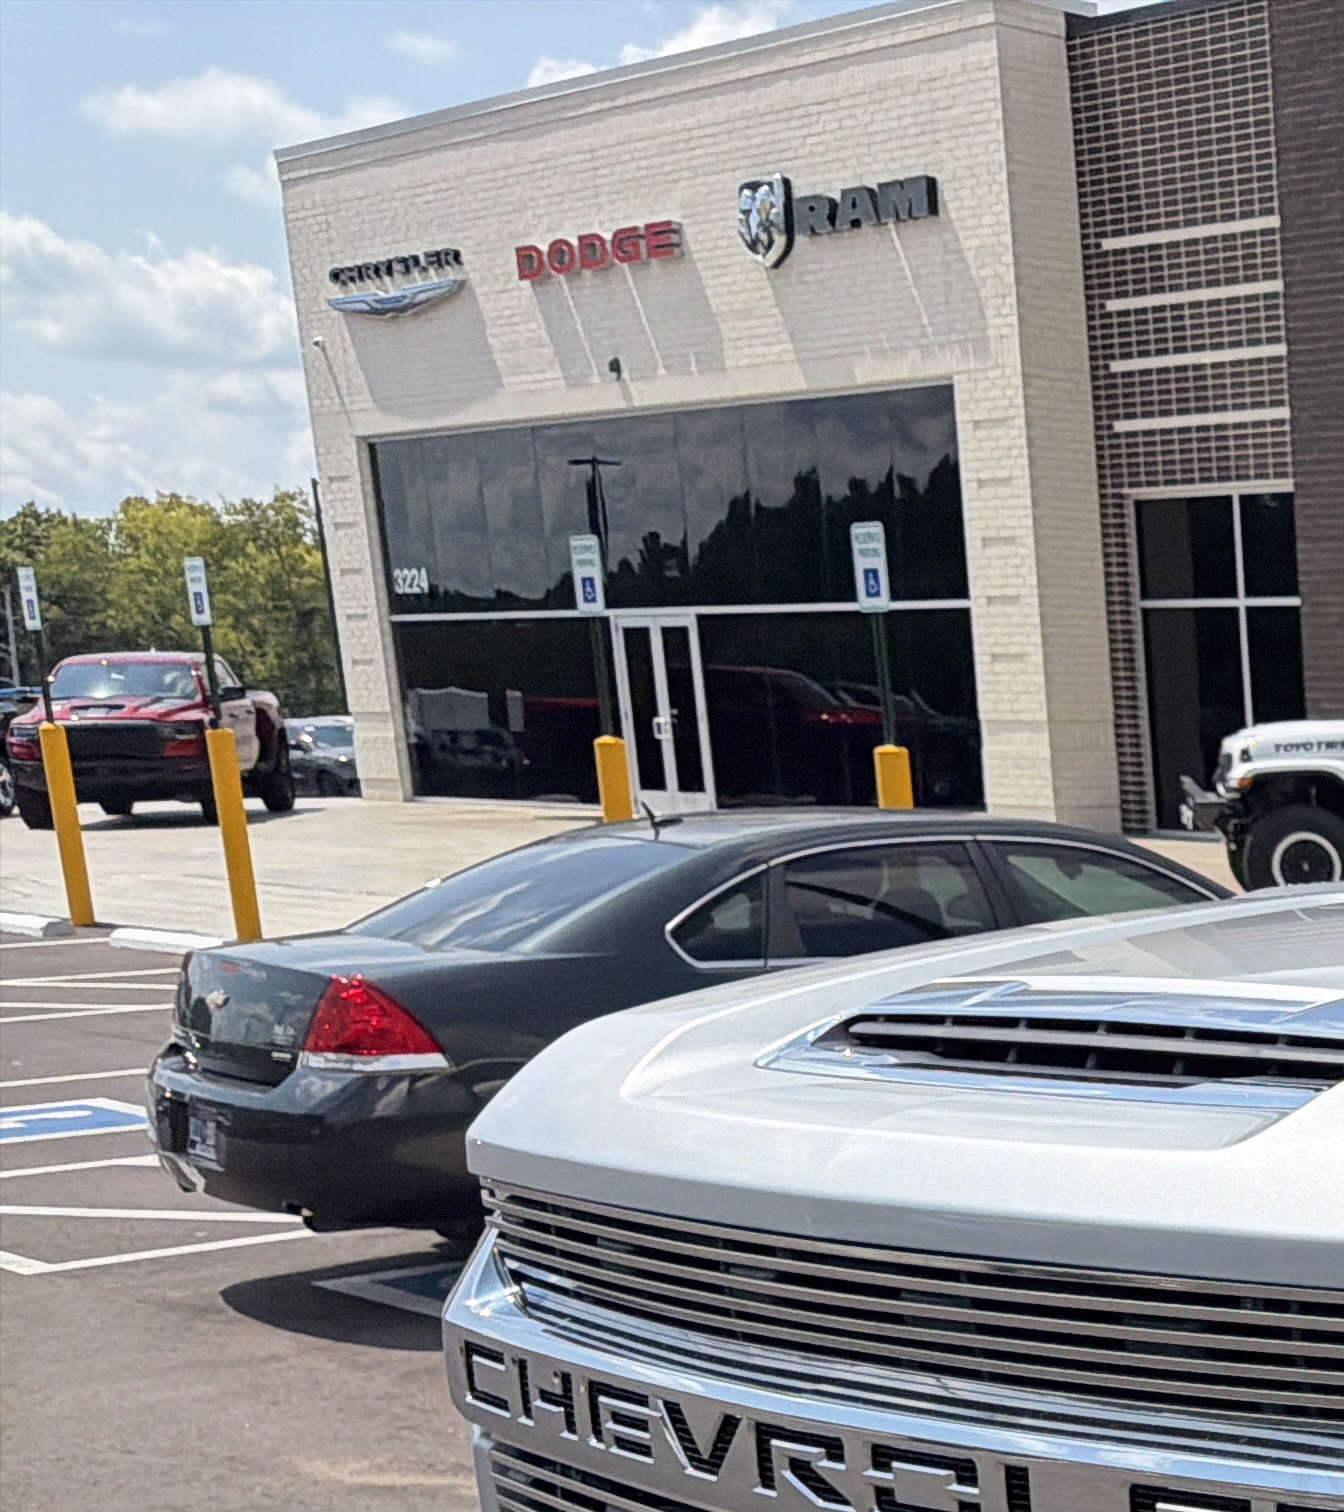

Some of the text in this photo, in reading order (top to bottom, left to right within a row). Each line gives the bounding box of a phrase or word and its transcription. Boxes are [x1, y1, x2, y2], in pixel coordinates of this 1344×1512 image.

[799, 175, 939, 236] RAM
[329, 248, 463, 286] CHRYSLER
[515, 220, 682, 281] DODGE
[393, 567, 429, 594] 3224
[1274, 741, 1314, 753] TOYO
